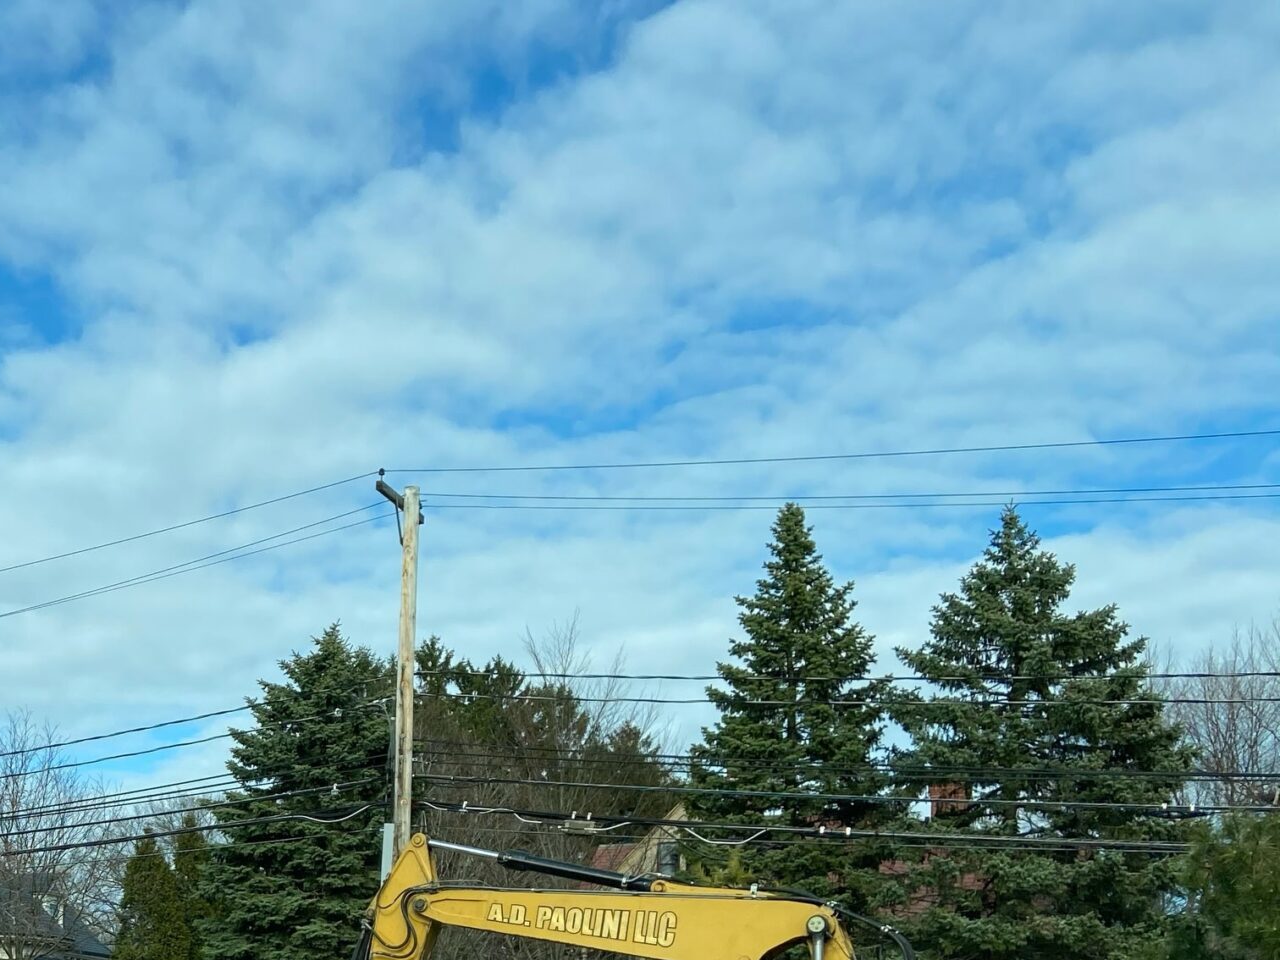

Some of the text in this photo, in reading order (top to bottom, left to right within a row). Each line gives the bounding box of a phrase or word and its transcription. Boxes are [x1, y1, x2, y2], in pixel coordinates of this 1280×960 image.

[487, 903, 678, 947] A.D. PAOLINI LLC
